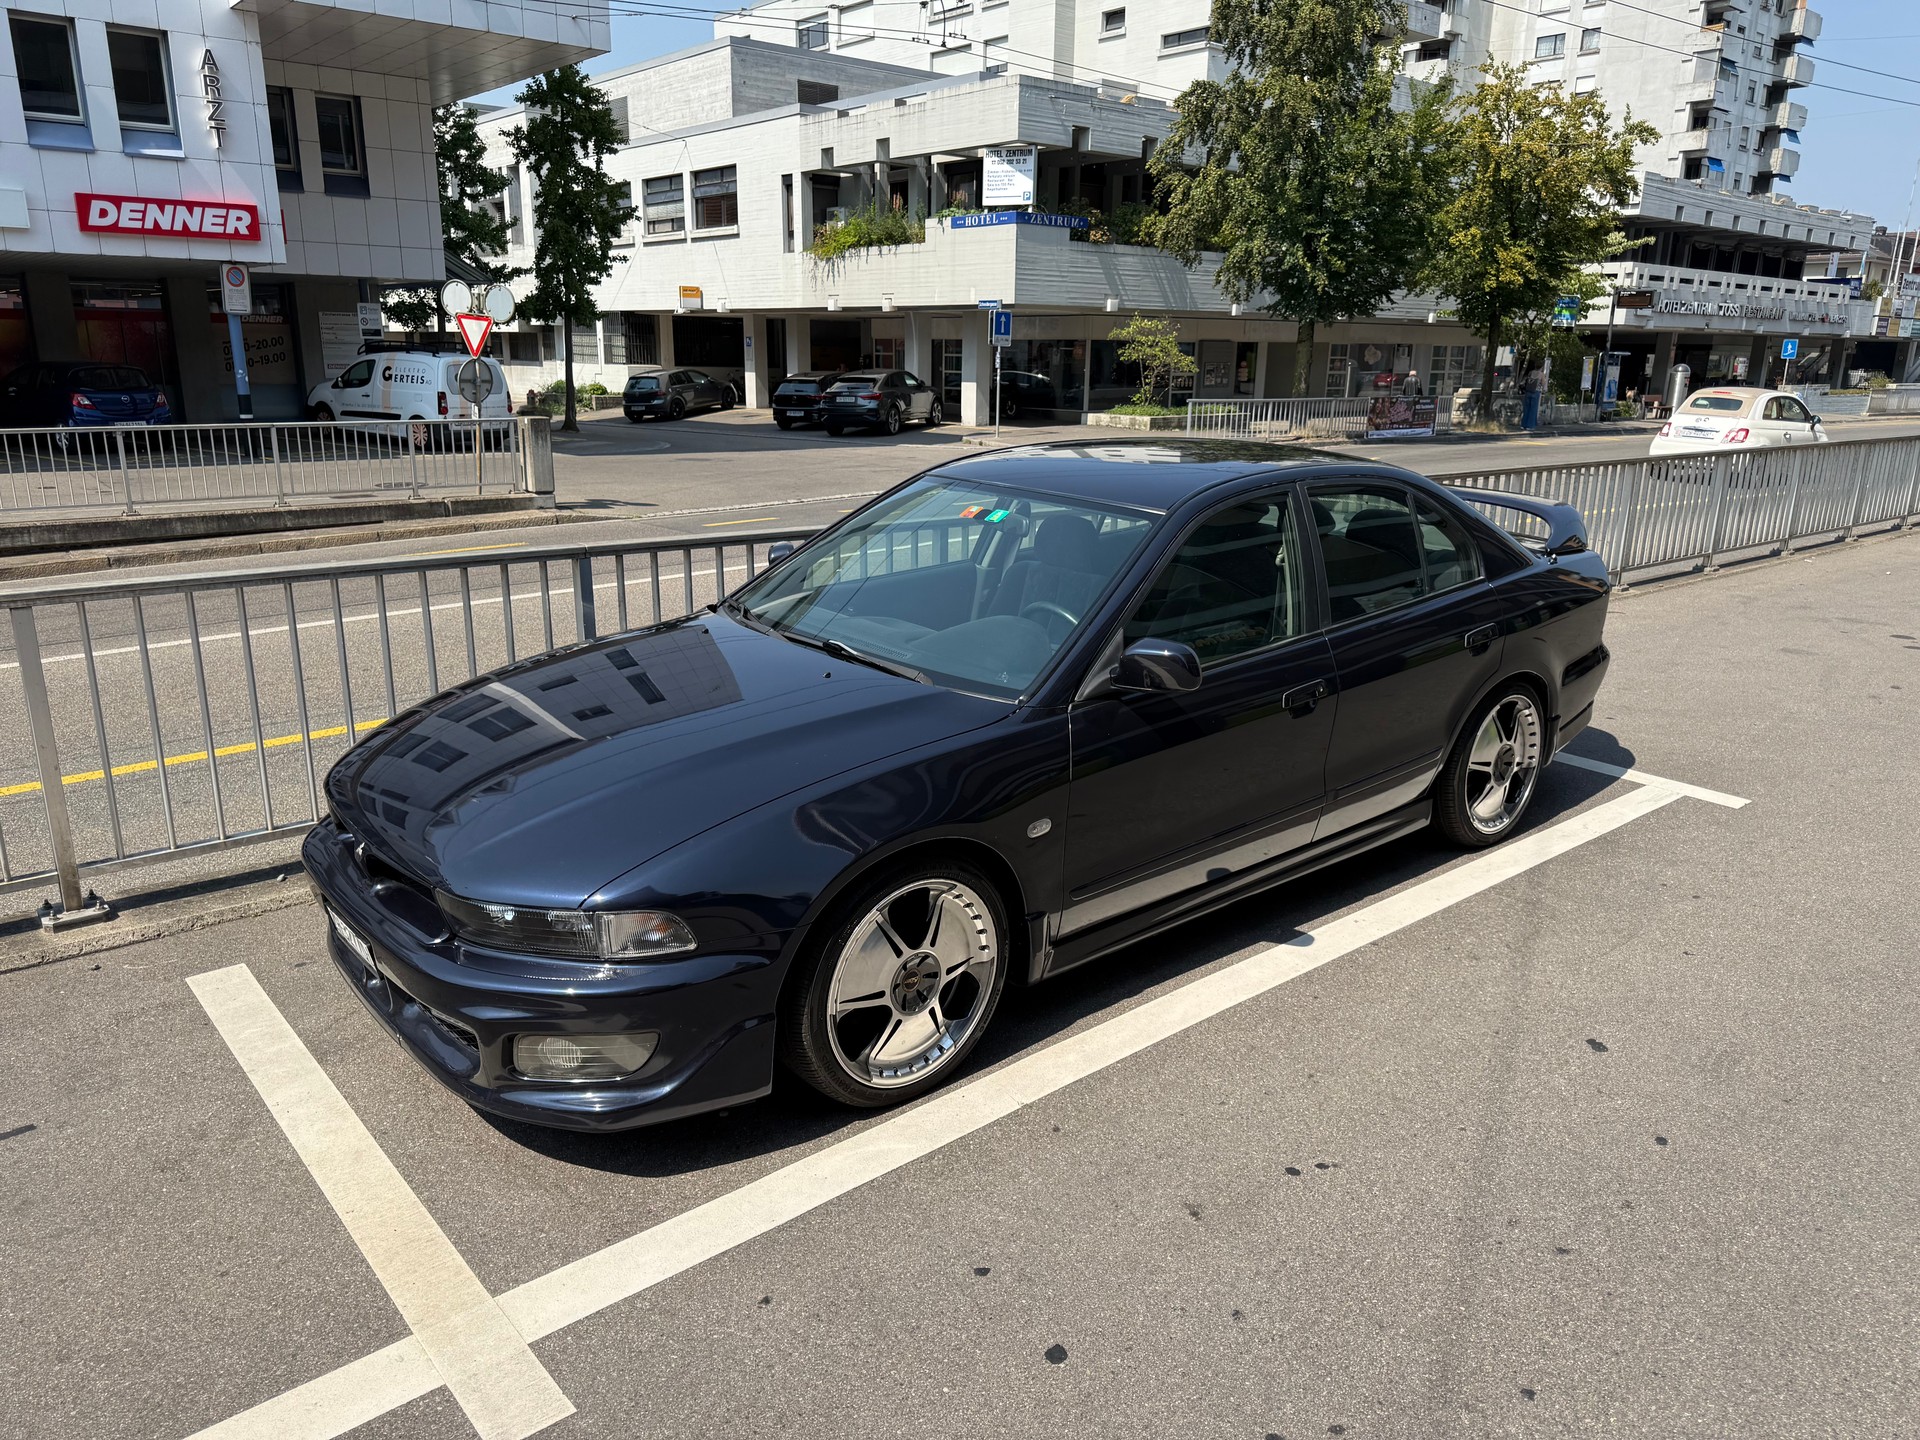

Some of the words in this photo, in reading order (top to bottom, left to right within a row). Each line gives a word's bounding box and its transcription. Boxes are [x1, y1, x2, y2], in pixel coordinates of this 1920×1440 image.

[199, 48, 227, 149] ARZT
[986, 150, 1003, 158] HOTEL
[1005, 149, 1033, 157] ZENTRUM
[88, 199, 251, 235] DENNER
[965, 214, 998, 227] HOTEL
[1030, 214, 1079, 228] ZENTRUM
[1658, 299, 1680, 313] HOTEL
[242, 315, 283, 323] DENNER
[382, 365, 425, 385] GERTEIS
[395, 366, 426, 374] ELEKTRO
